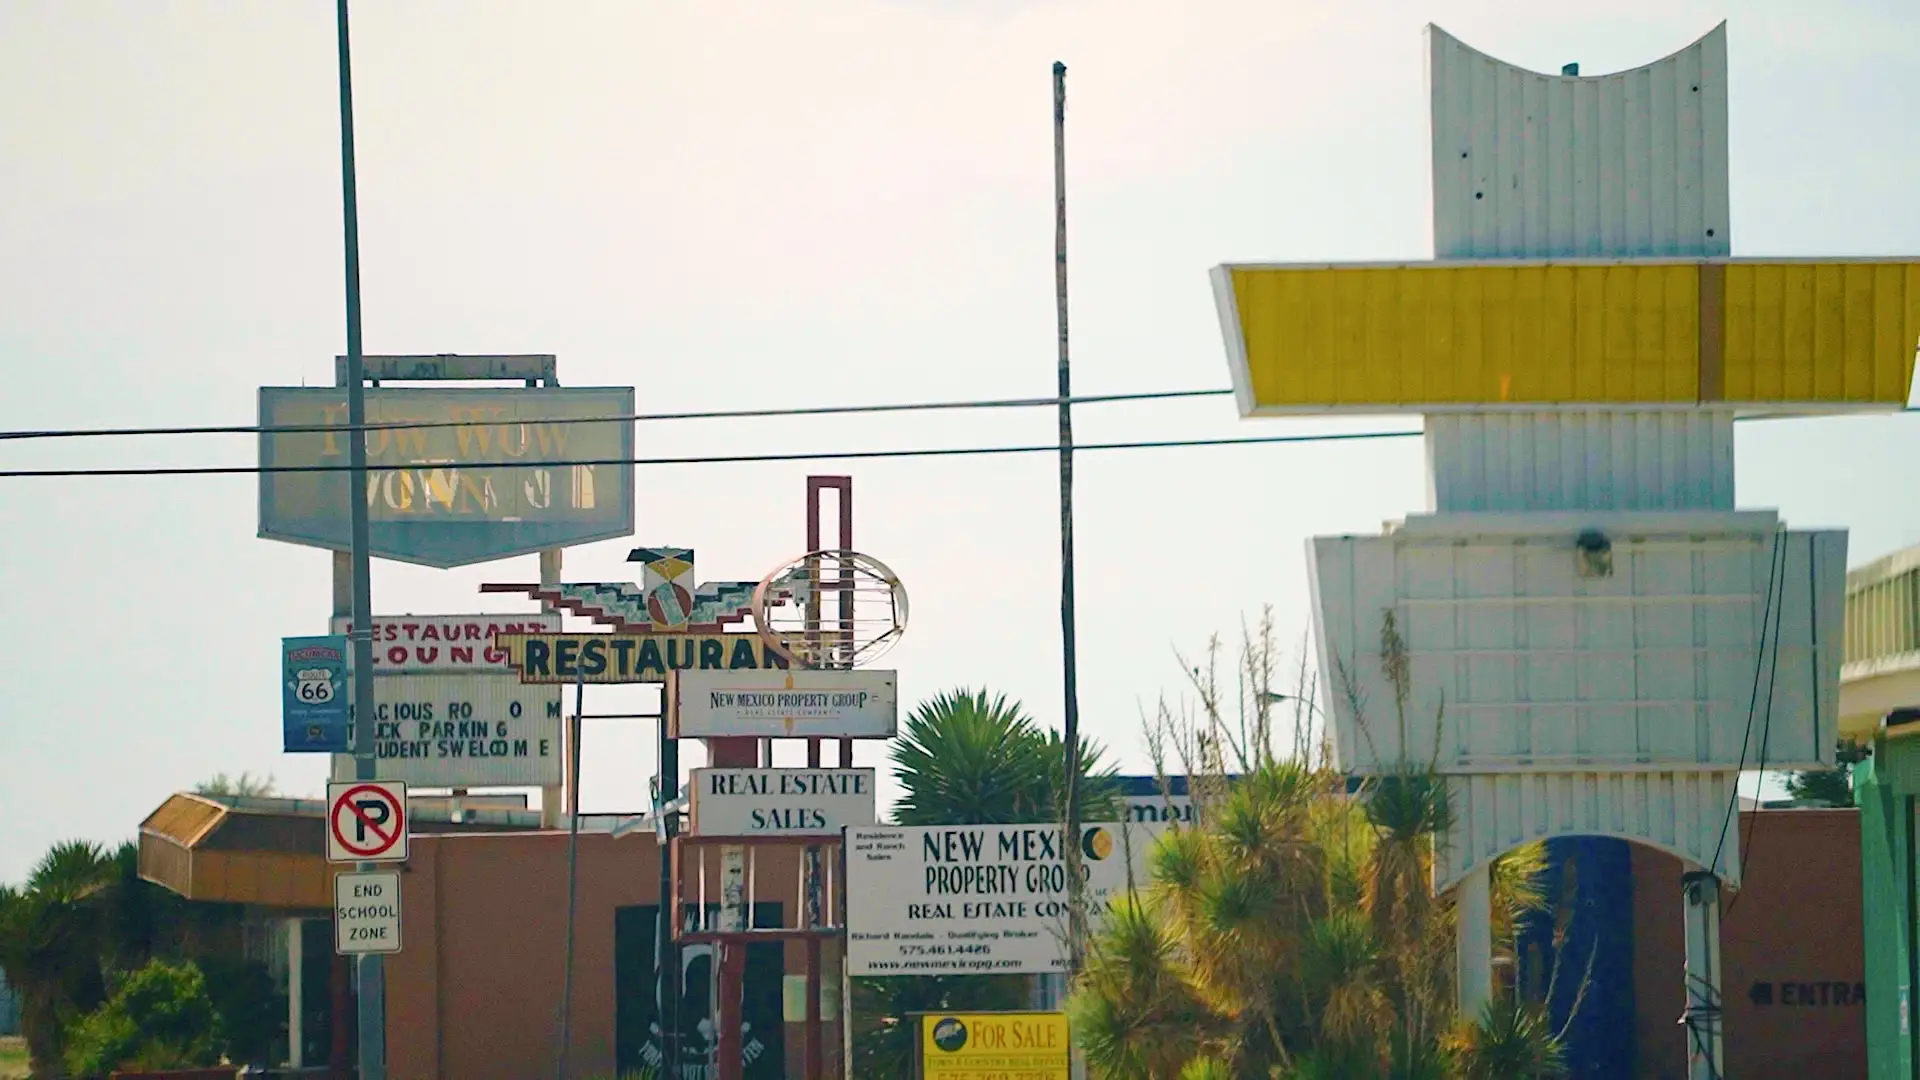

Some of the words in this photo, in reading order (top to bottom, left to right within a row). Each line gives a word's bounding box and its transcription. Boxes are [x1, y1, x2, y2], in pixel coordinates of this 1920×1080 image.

[448, 405, 569, 457] WOW
[347, 623, 547, 641] ESTAURANT
[372, 646, 505, 665] OUNG
[525, 639, 790, 676] RESTAURAN
[302, 682, 328, 700] 66
[710, 692, 734, 708] NEW
[737, 693, 775, 707] MEXICO
[778, 693, 828, 707] PROPERTY
[832, 692, 867, 708] GROUP
[711, 774, 769, 796] REAL
[780, 773, 868, 795] ESTATE
[751, 808, 826, 829] SALES
[923, 831, 984, 862] NEW
[926, 865, 1019, 895] PROPERTY
[354, 885, 382, 898] END
[339, 905, 397, 919] SCHOOL
[908, 904, 955, 919] REAL
[964, 902, 1026, 919] ESTATE
[349, 927, 388, 941] ZONE
[851, 931, 890, 940] Richard
[948, 931, 999, 941] Qualifying
[1003, 930, 1038, 938] Broker
[868, 959, 1022, 970] www.newmexicopg.com
[972, 1021, 1006, 1048] FOR
[1012, 1020, 1057, 1048] SALE
